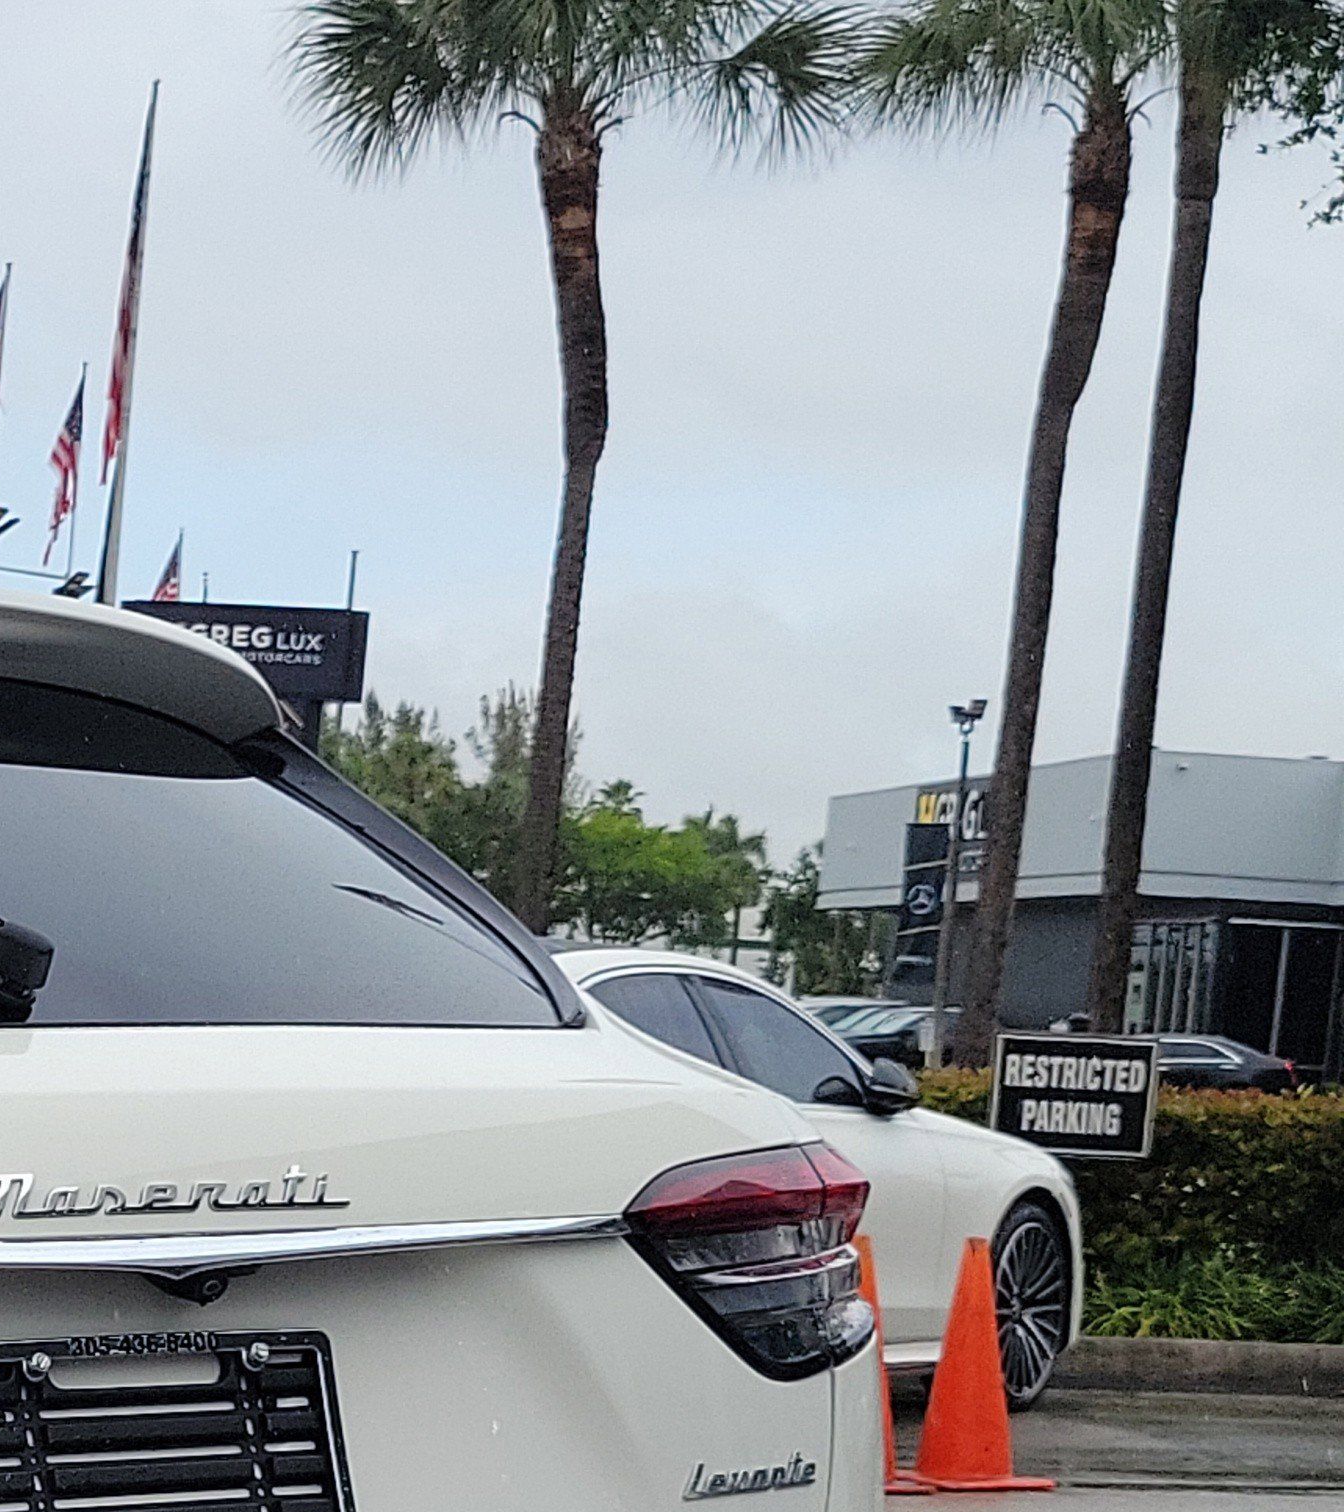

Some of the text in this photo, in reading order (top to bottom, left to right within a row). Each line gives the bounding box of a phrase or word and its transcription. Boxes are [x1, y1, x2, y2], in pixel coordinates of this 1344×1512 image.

[276, 630, 324, 651] LUX
[1003, 1053, 1148, 1093] RESTRICTED
[1019, 1099, 1123, 1136] PARKING
[681, 1450, 816, 1501] Levante
